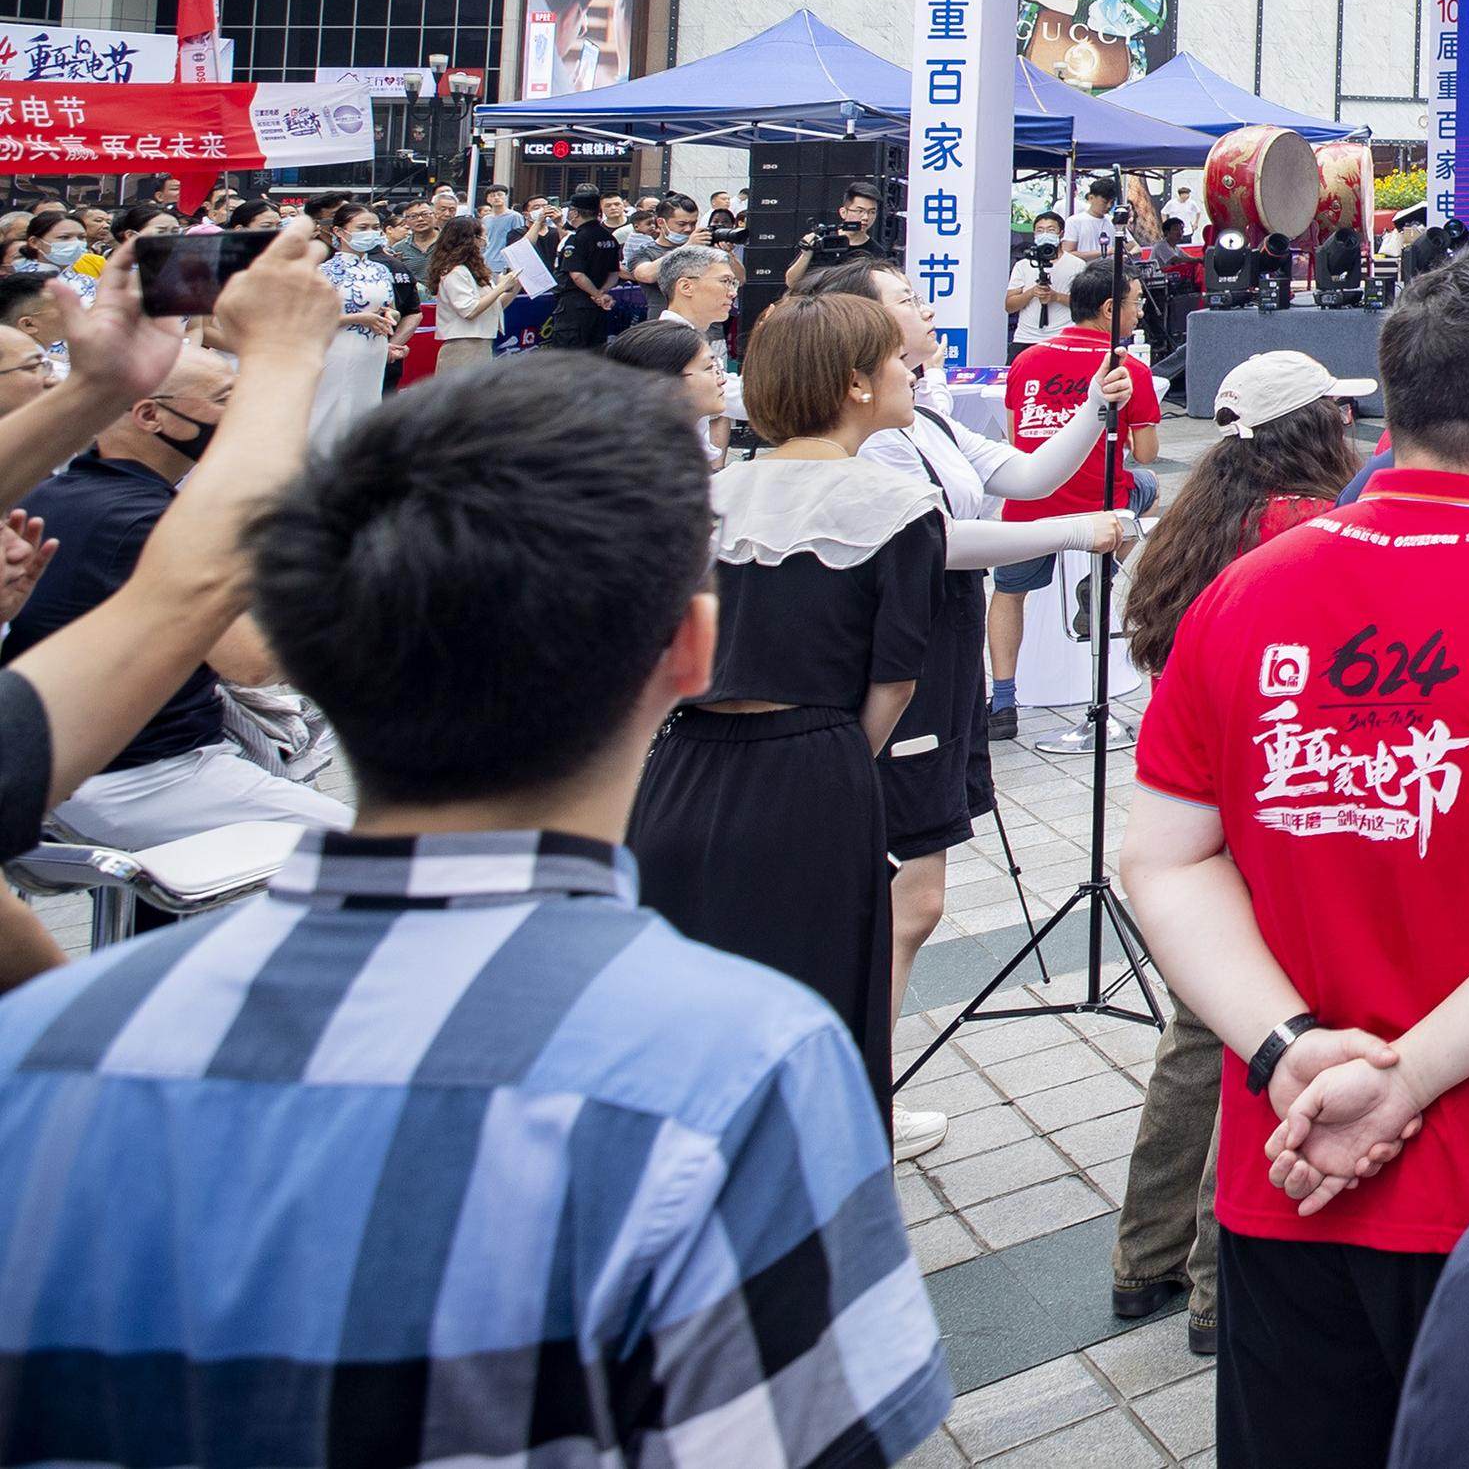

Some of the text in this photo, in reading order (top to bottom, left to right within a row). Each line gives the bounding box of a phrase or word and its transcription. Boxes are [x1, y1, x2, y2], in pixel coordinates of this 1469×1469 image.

[24, 33, 139, 83] 重百家电节
[101, 133, 227, 160] 再启未来
[525, 143, 553, 155] ICBC
[1320, 624, 1460, 697] 624
